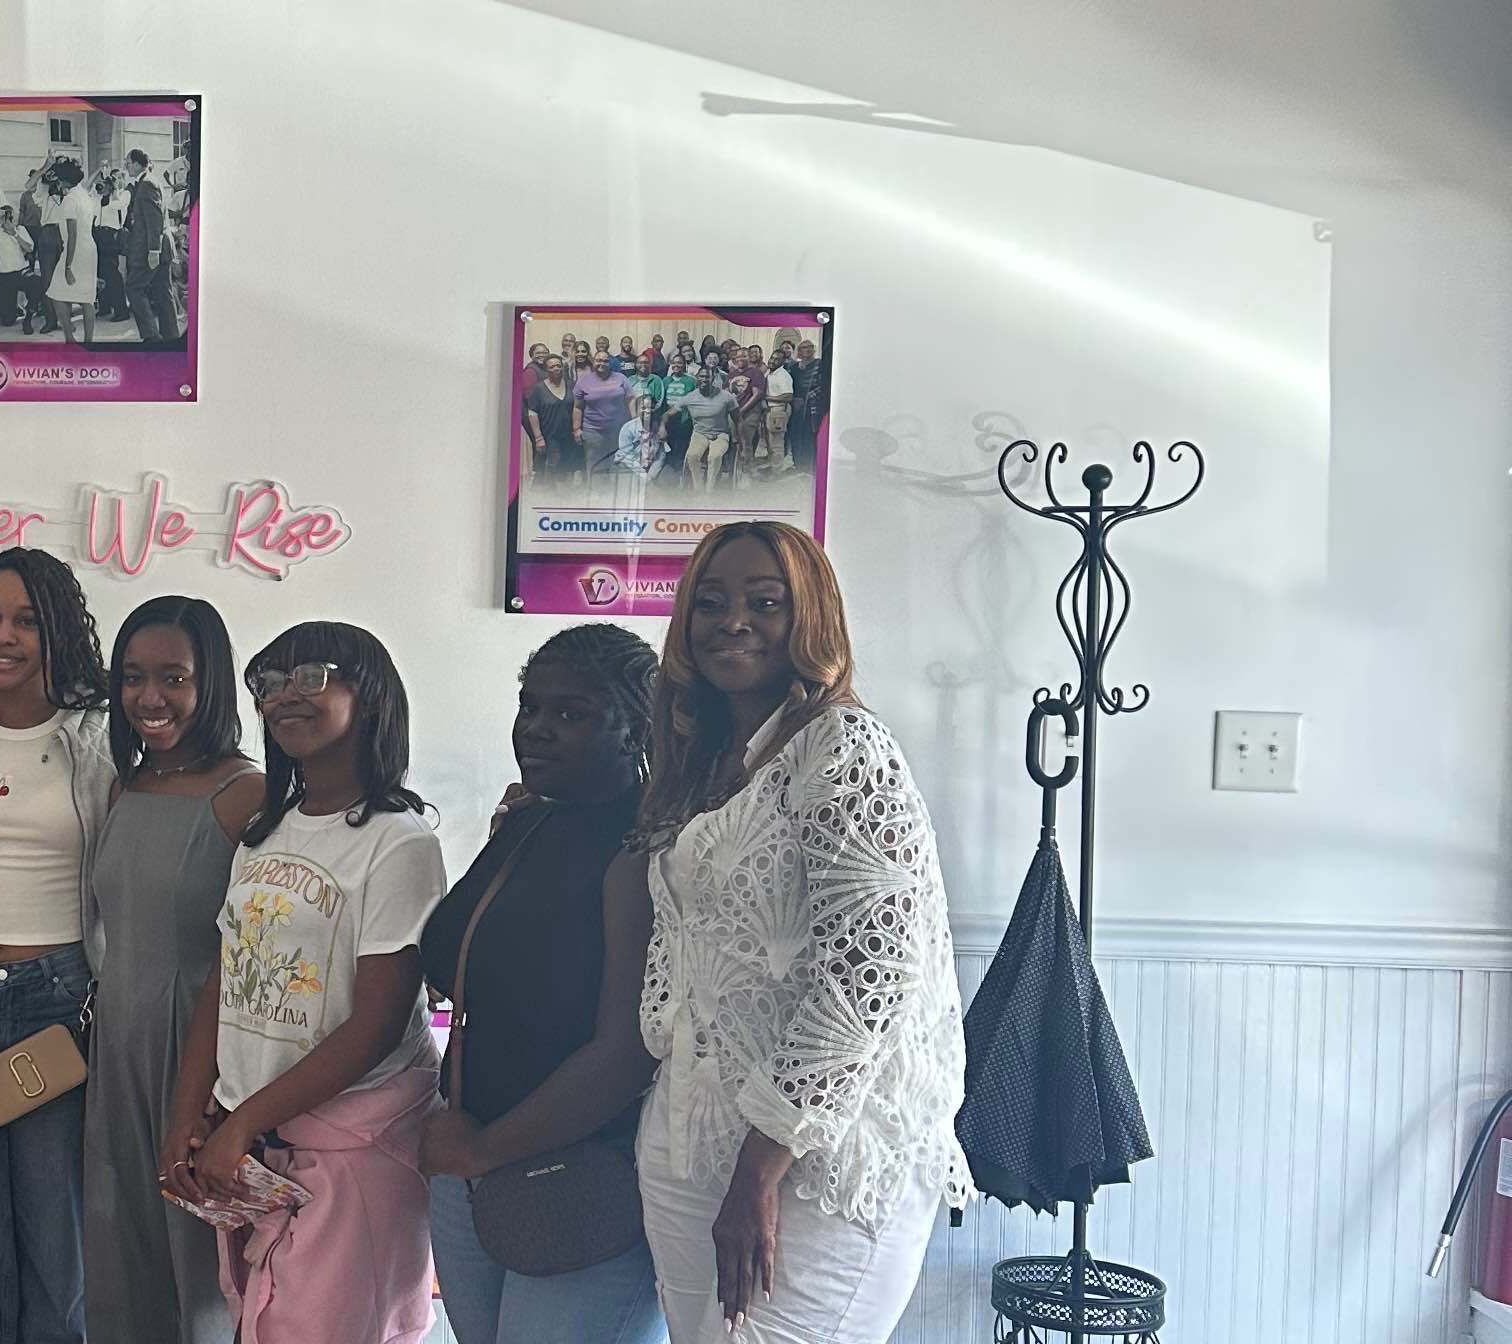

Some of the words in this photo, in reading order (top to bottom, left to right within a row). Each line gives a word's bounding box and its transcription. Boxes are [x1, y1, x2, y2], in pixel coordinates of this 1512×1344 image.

[13, 367, 74, 379] VIVIAN'S
[79, 368, 119, 379] DOOR
[88, 480, 196, 575] We
[226, 482, 343, 577] Rise
[538, 516, 648, 537] Community
[625, 581, 678, 593] VIVIAN
